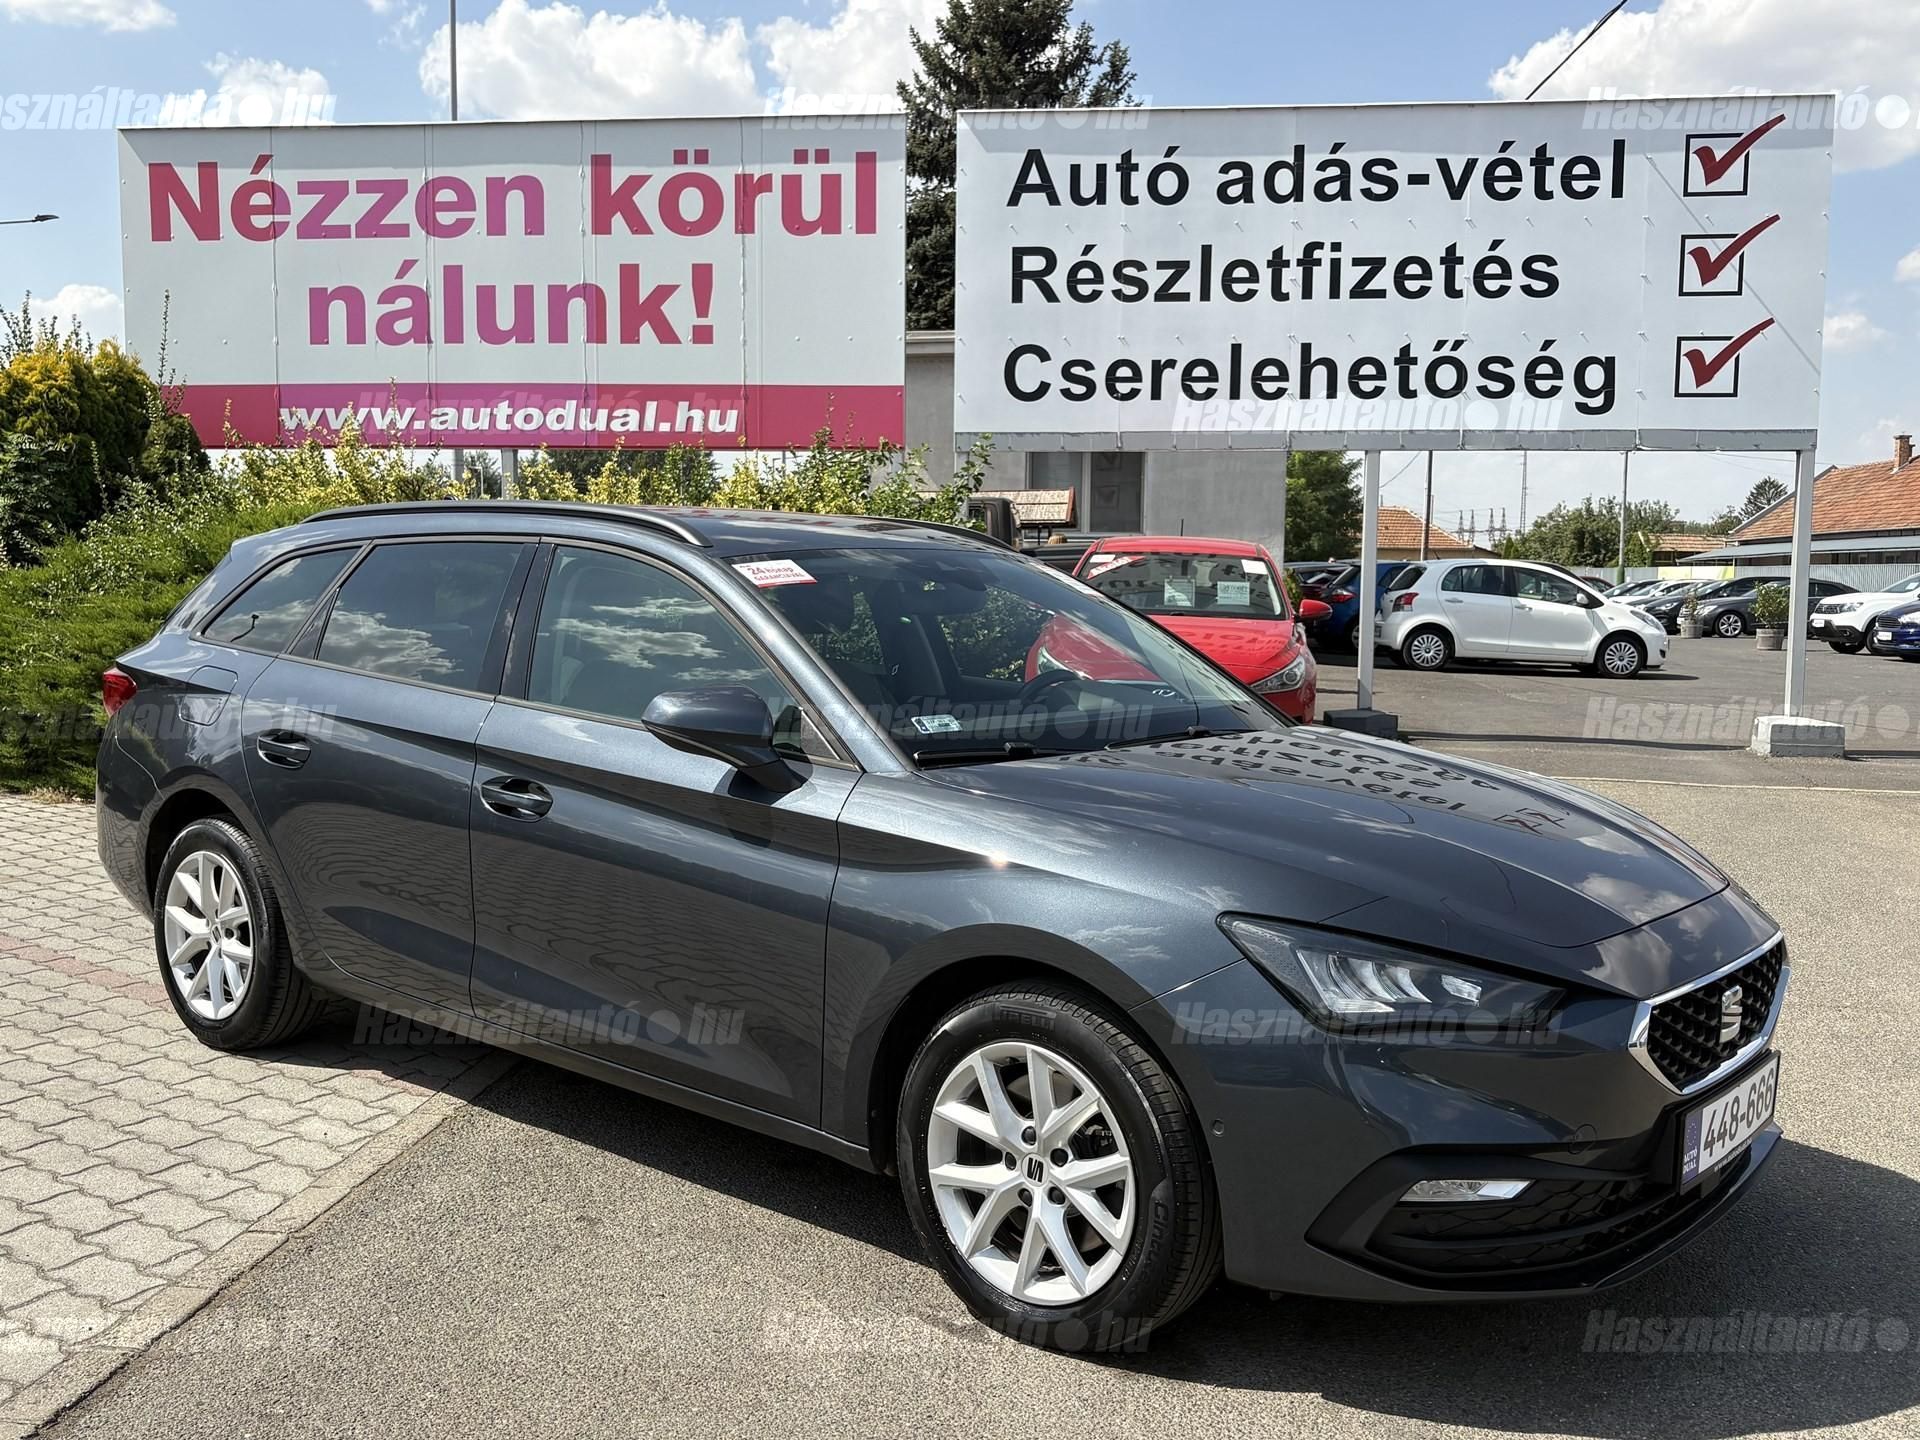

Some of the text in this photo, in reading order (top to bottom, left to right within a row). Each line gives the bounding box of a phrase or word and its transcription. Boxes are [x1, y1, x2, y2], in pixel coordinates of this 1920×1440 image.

[149, 149, 877, 242] Nézzen körül
[1006, 139, 1626, 207] Autó adás-vétel
[309, 259, 713, 345] nálunk!
[1011, 239, 1560, 304] Részletfizetés
[1003, 340, 1616, 416] Cserelehetőség
[279, 400, 739, 433] www.autodual.hu
[1703, 1067, 1774, 1158] 448-666
